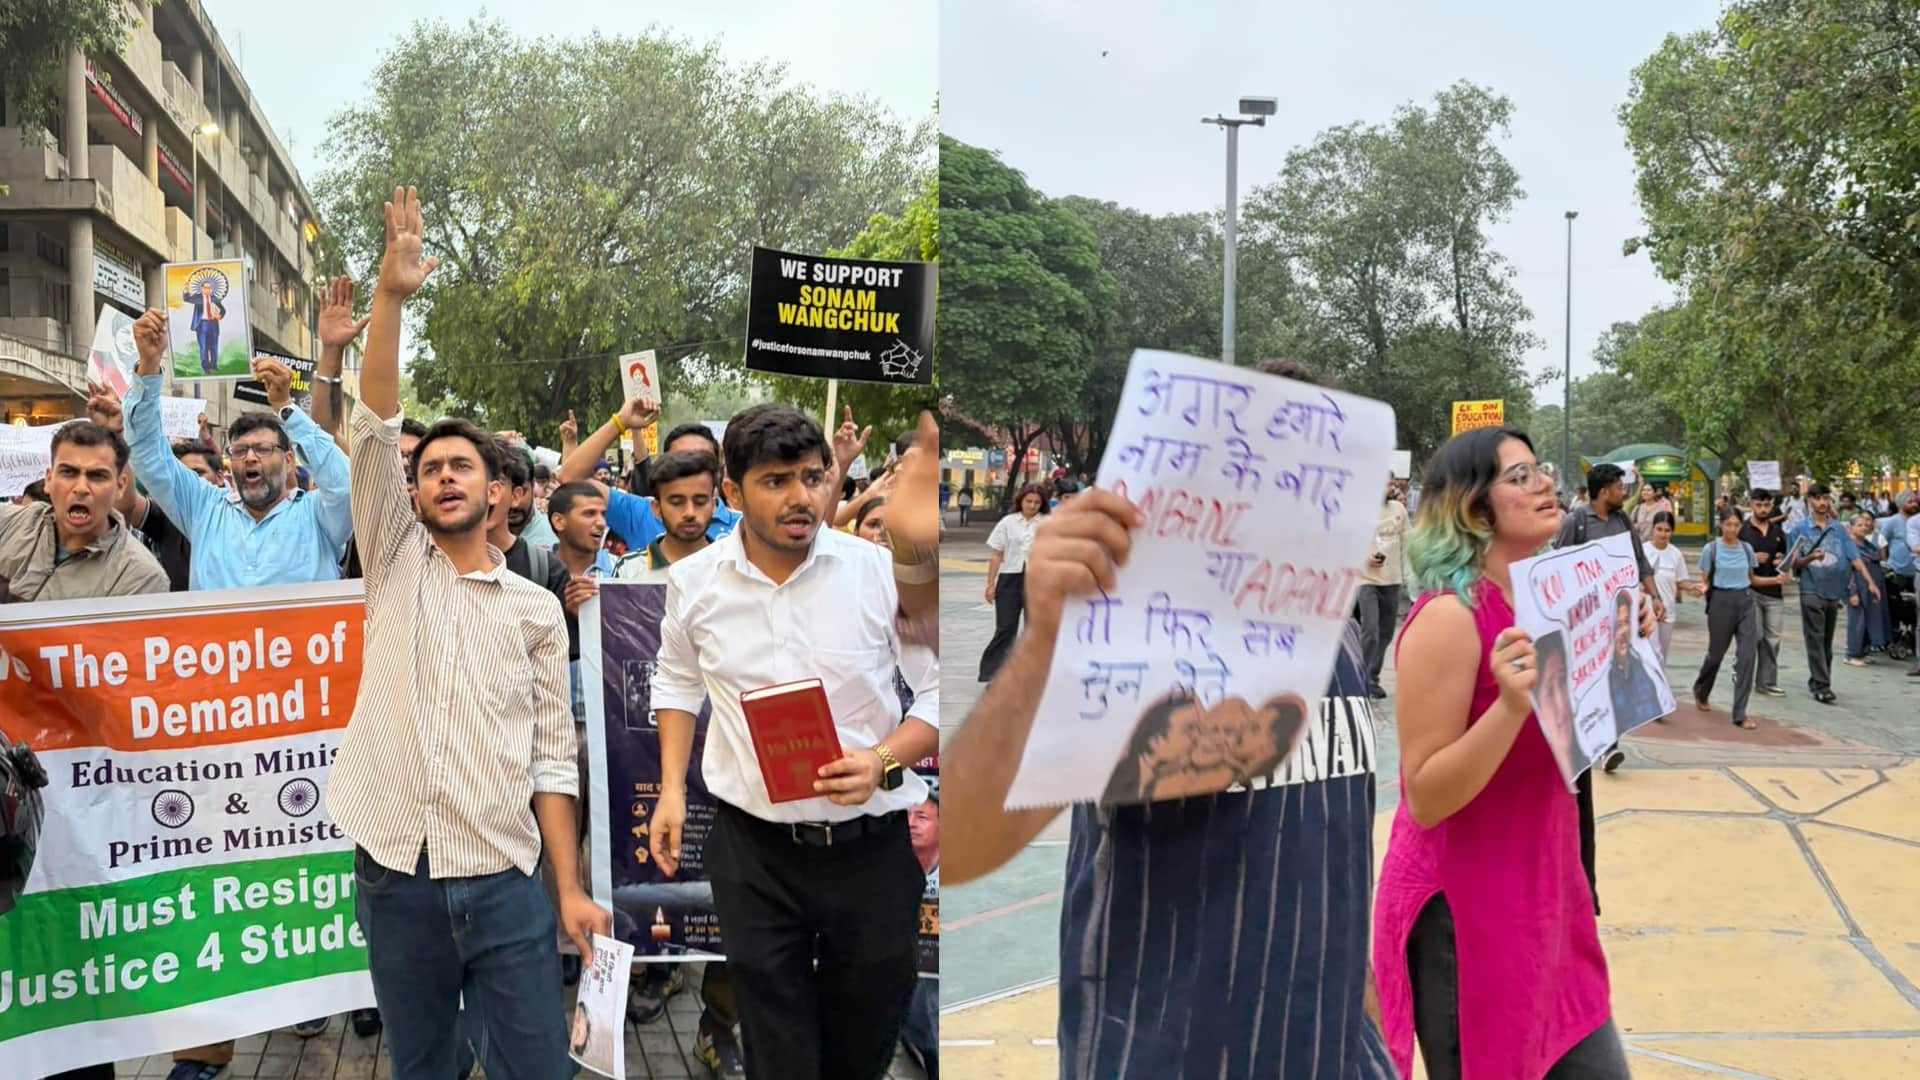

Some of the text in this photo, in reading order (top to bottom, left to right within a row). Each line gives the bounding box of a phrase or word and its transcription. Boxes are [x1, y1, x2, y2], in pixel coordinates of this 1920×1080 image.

[780, 258, 903, 288] WE SUPPORT
[800, 284, 876, 311] SONAM
[778, 302, 900, 334] WANGCHUK
[752, 338, 871, 361] #justiceforsonamwangchuk
[1138, 368, 1349, 452] अगर हमारे
[1117, 434, 1353, 531] नाम के बाद
[1076, 576, 1123, 645] तो
[1144, 591, 1212, 650] फिर
[1206, 551, 1361, 619] या ADANI
[39, 643, 128, 689] The
[144, 627, 293, 684] People
[306, 620, 347, 665] of
[130, 676, 330, 739] Demand !
[71, 759, 243, 788] Education
[224, 792, 250, 815] &
[108, 835, 213, 869] Prime
[79, 883, 197, 940] Must
[0, 951, 180, 1014] Justice
[196, 931, 224, 972] 4
